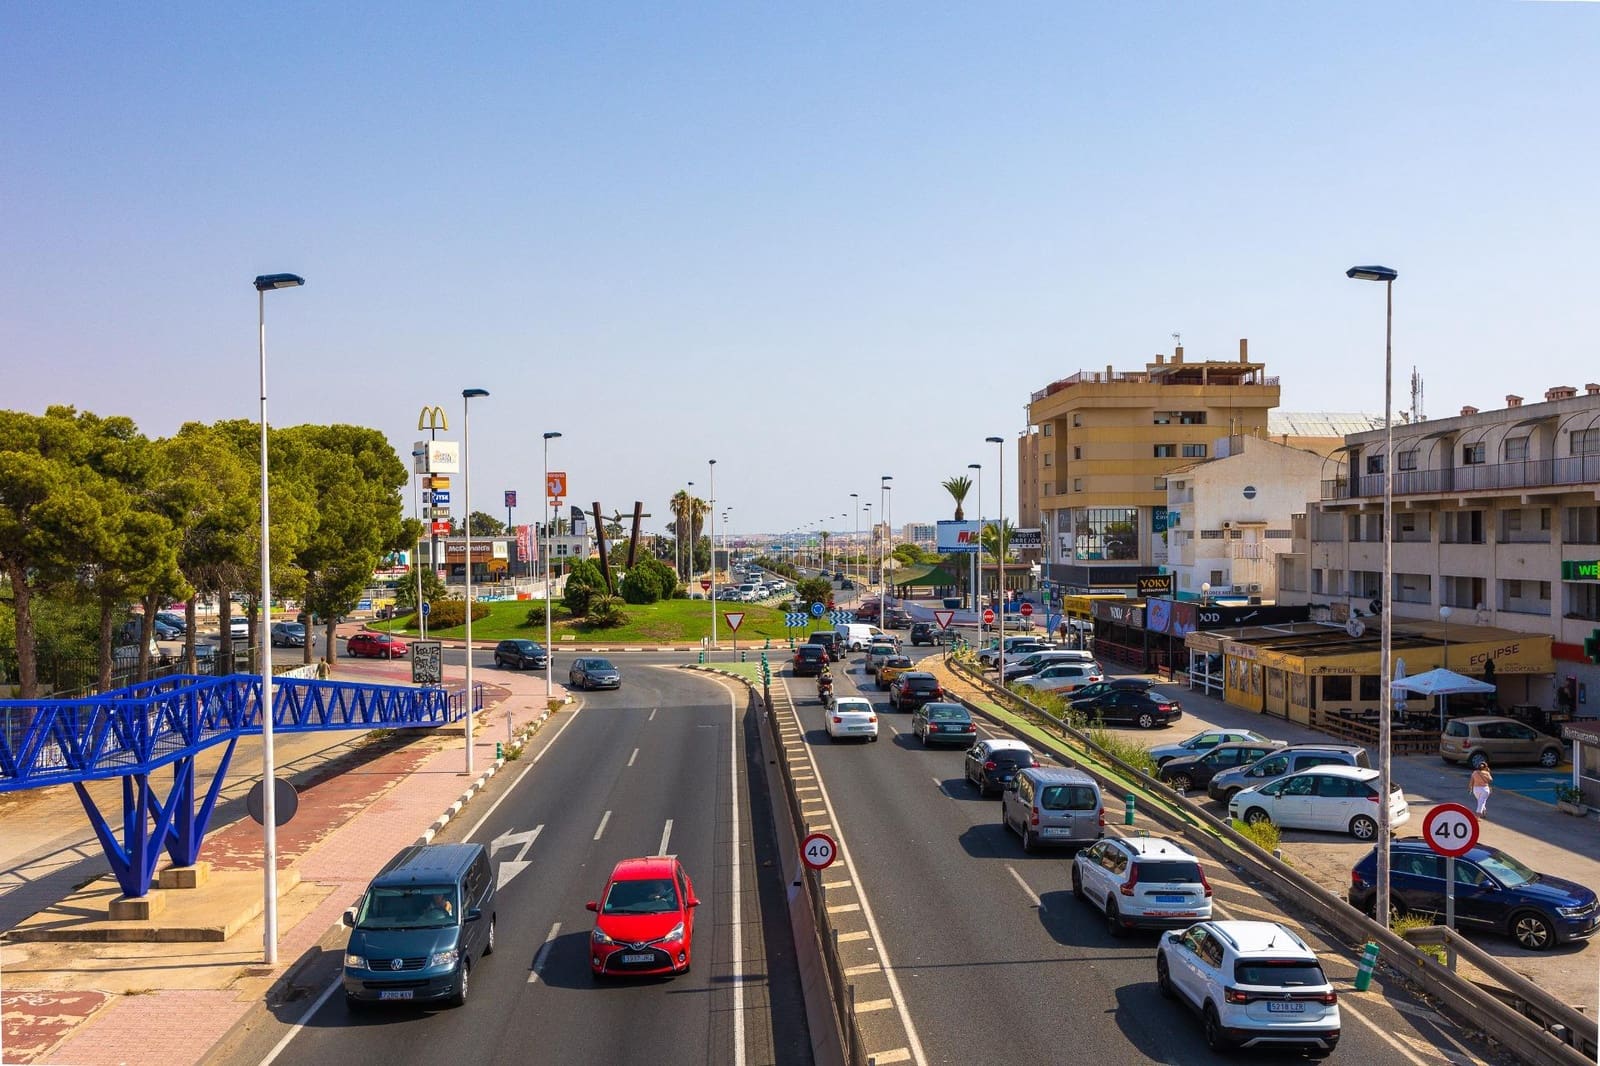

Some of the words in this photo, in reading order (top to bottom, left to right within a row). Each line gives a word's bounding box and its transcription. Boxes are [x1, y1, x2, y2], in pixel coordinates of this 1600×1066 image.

[1470, 643, 1520, 666] ECLIPSE
[1434, 822, 1468, 839] 40
[808, 845, 829, 858] 40
